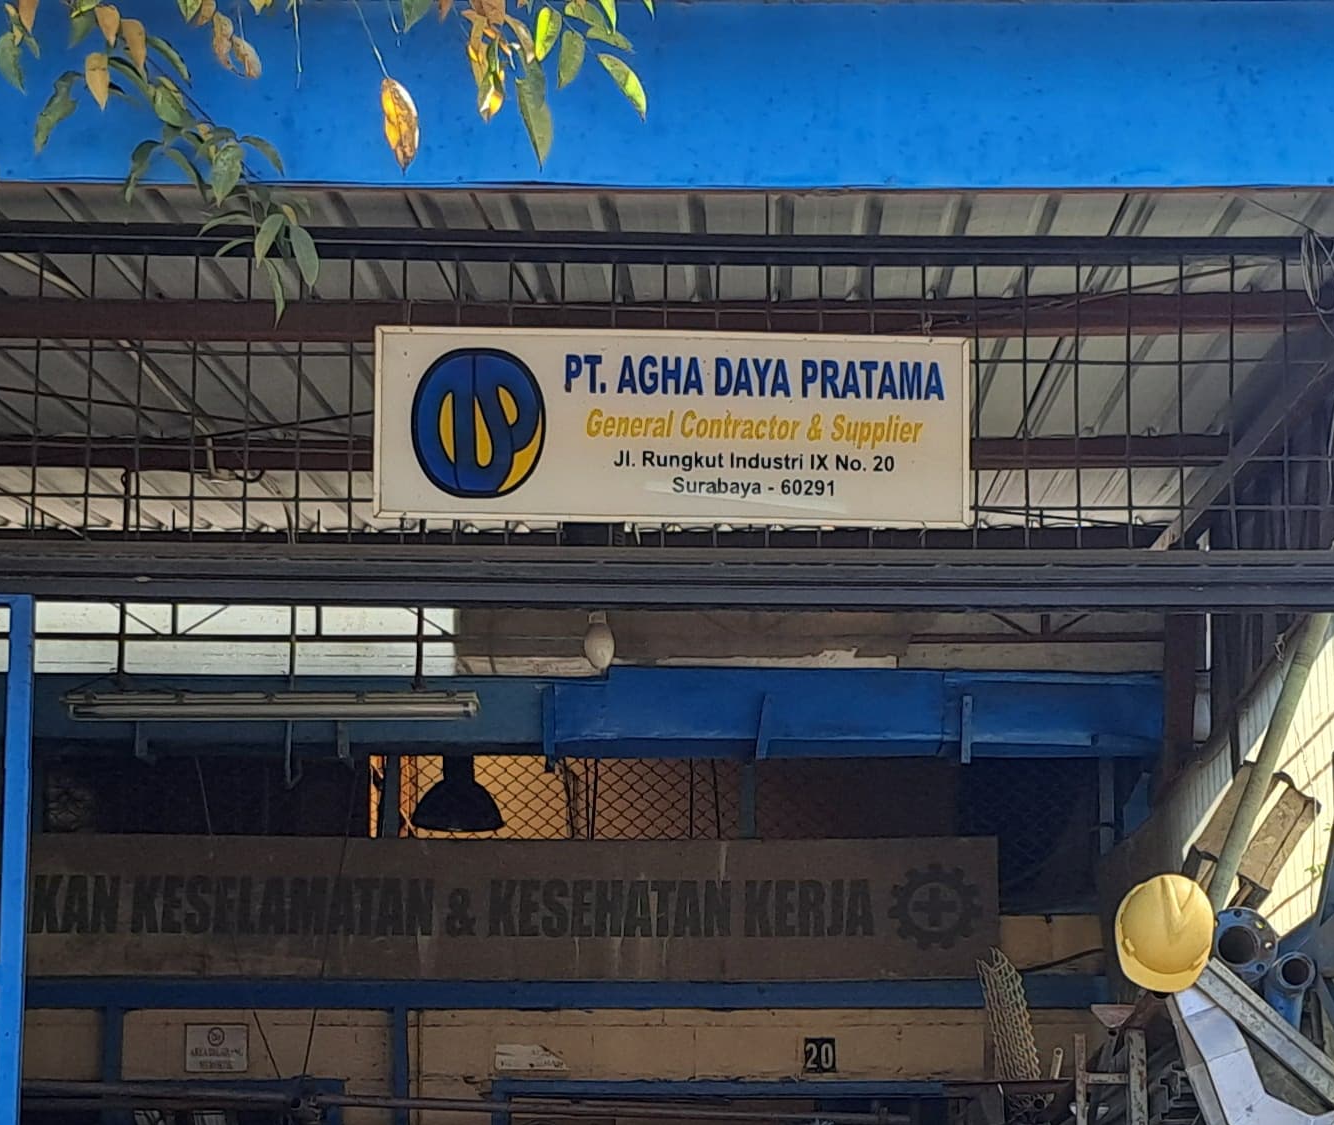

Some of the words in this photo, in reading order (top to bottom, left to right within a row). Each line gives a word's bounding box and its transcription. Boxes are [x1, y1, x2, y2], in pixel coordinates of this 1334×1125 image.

[565, 355, 606, 393] PT.
[617, 355, 703, 394] AGHA
[714, 357, 792, 397] DAYA
[801, 359, 946, 400] PRATAMA
[585, 408, 674, 439] General
[679, 409, 800, 442] Contractor
[805, 413, 823, 441] &
[829, 413, 924, 451] Supplier
[642, 450, 724, 472] Rungkut
[730, 452, 804, 470] Industri
[810, 453, 829, 471] IX
[835, 454, 867, 472] No.
[872, 455, 895, 472] 20
[672, 476, 762, 498] Surabaya
[780, 478, 835, 497] 60291
[130, 873, 435, 937] KESELAMATAN
[444, 886, 477, 939] &
[488, 877, 731, 938] KESEHATAN
[742, 879, 875, 938] KERJA
[805, 1042, 834, 1069] 20
